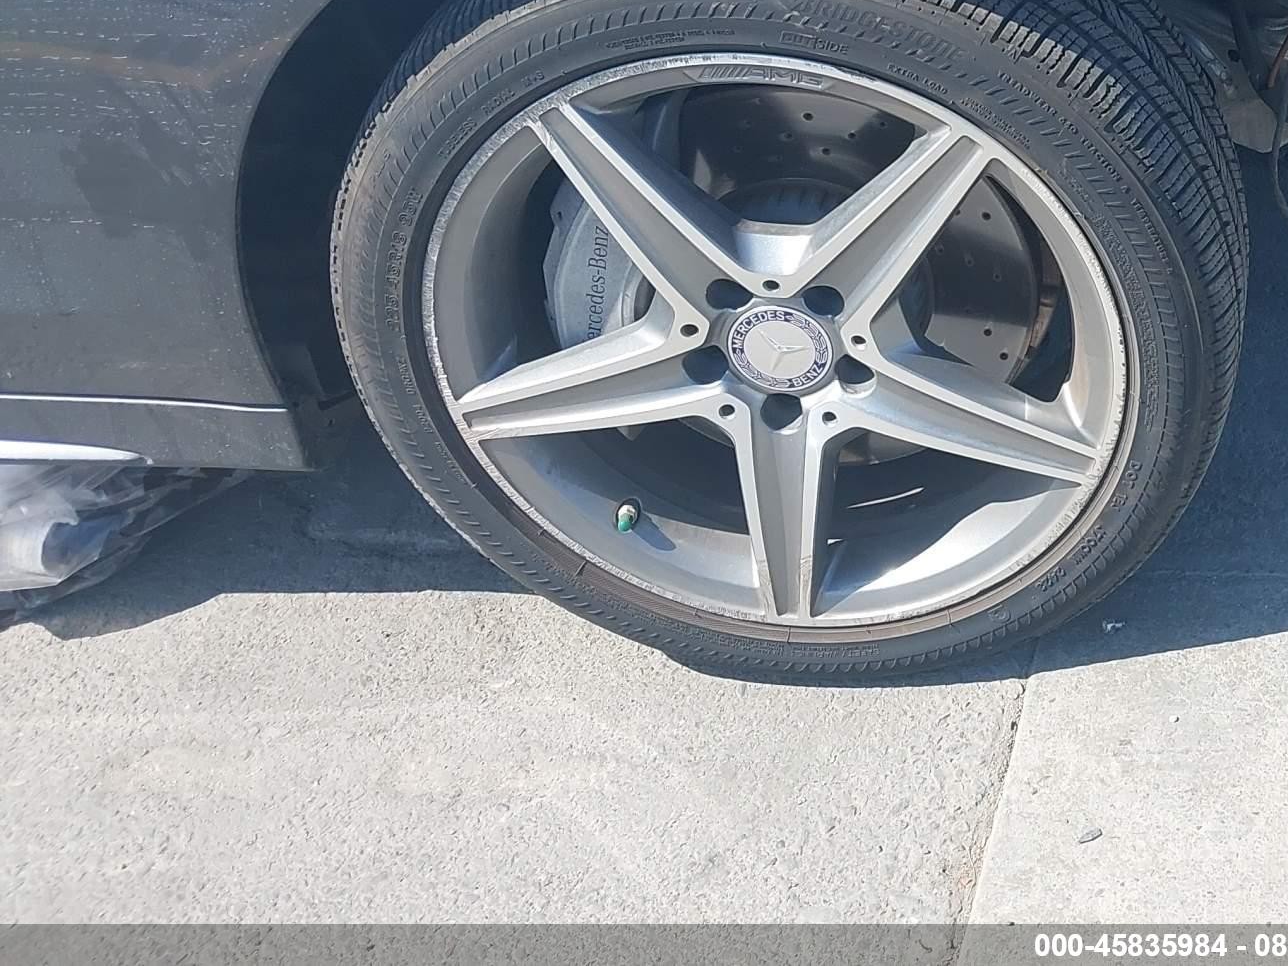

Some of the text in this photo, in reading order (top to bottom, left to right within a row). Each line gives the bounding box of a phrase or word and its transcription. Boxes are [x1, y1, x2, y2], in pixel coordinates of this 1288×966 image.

[887, 62, 949, 95] EXTRA LOAD
[583, 225, 609, 341] ercedes-Benz
[731, 310, 785, 349] MERCEDES
[791, 365, 823, 387] BENZ
